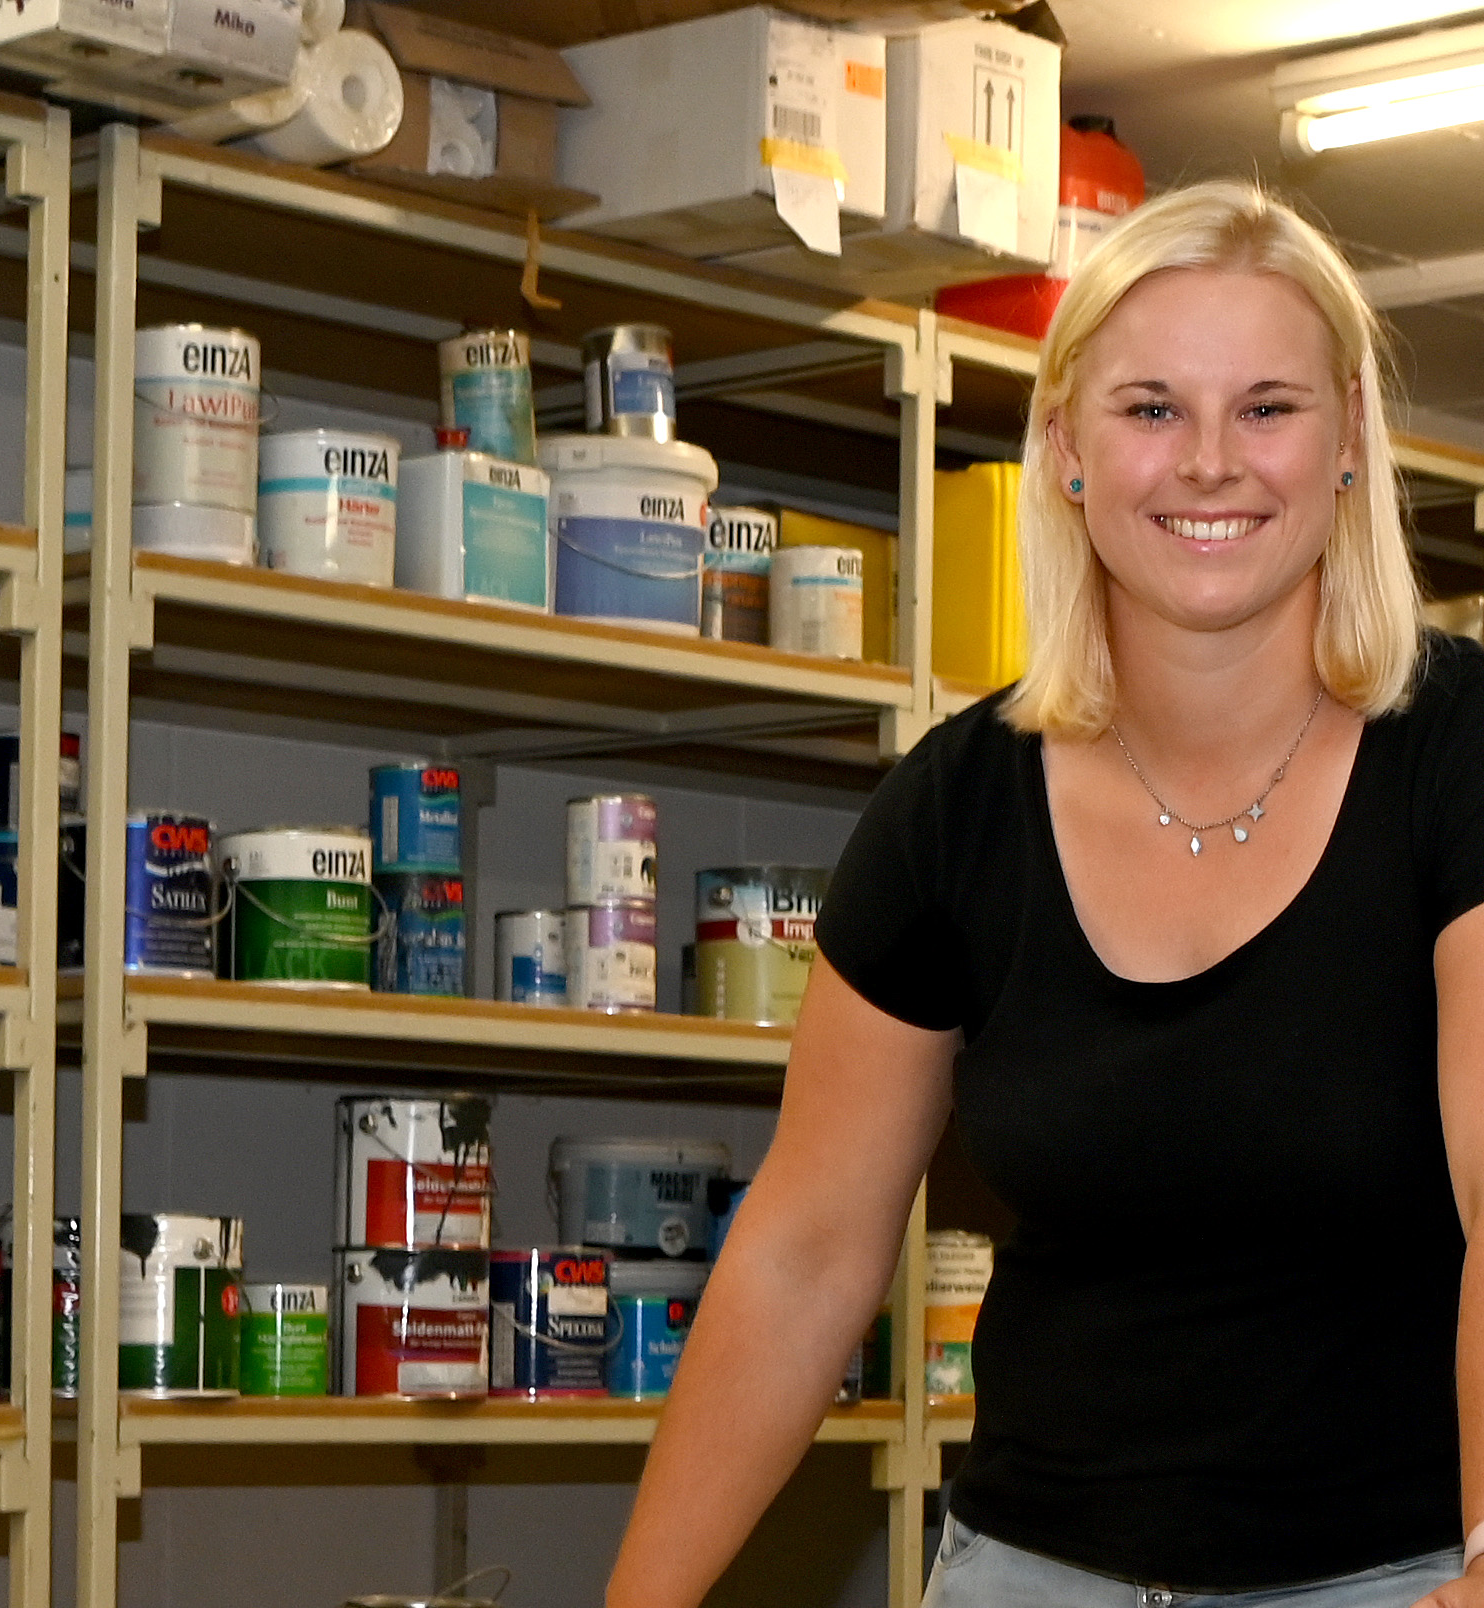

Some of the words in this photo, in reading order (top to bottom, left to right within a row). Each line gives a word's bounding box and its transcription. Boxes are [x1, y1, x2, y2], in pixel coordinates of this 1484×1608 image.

[214, 9, 256, 38] Miko
[183, 340, 251, 380] einzA
[466, 338, 521, 367] einzA
[323, 444, 389, 481] einzA
[640, 493, 685, 521] einzA
[709, 516, 777, 553] einzA
[837, 554, 862, 577] ein
[150, 823, 210, 854] CWS
[311, 846, 366, 881] einzA
[553, 1256, 605, 1284] CWS
